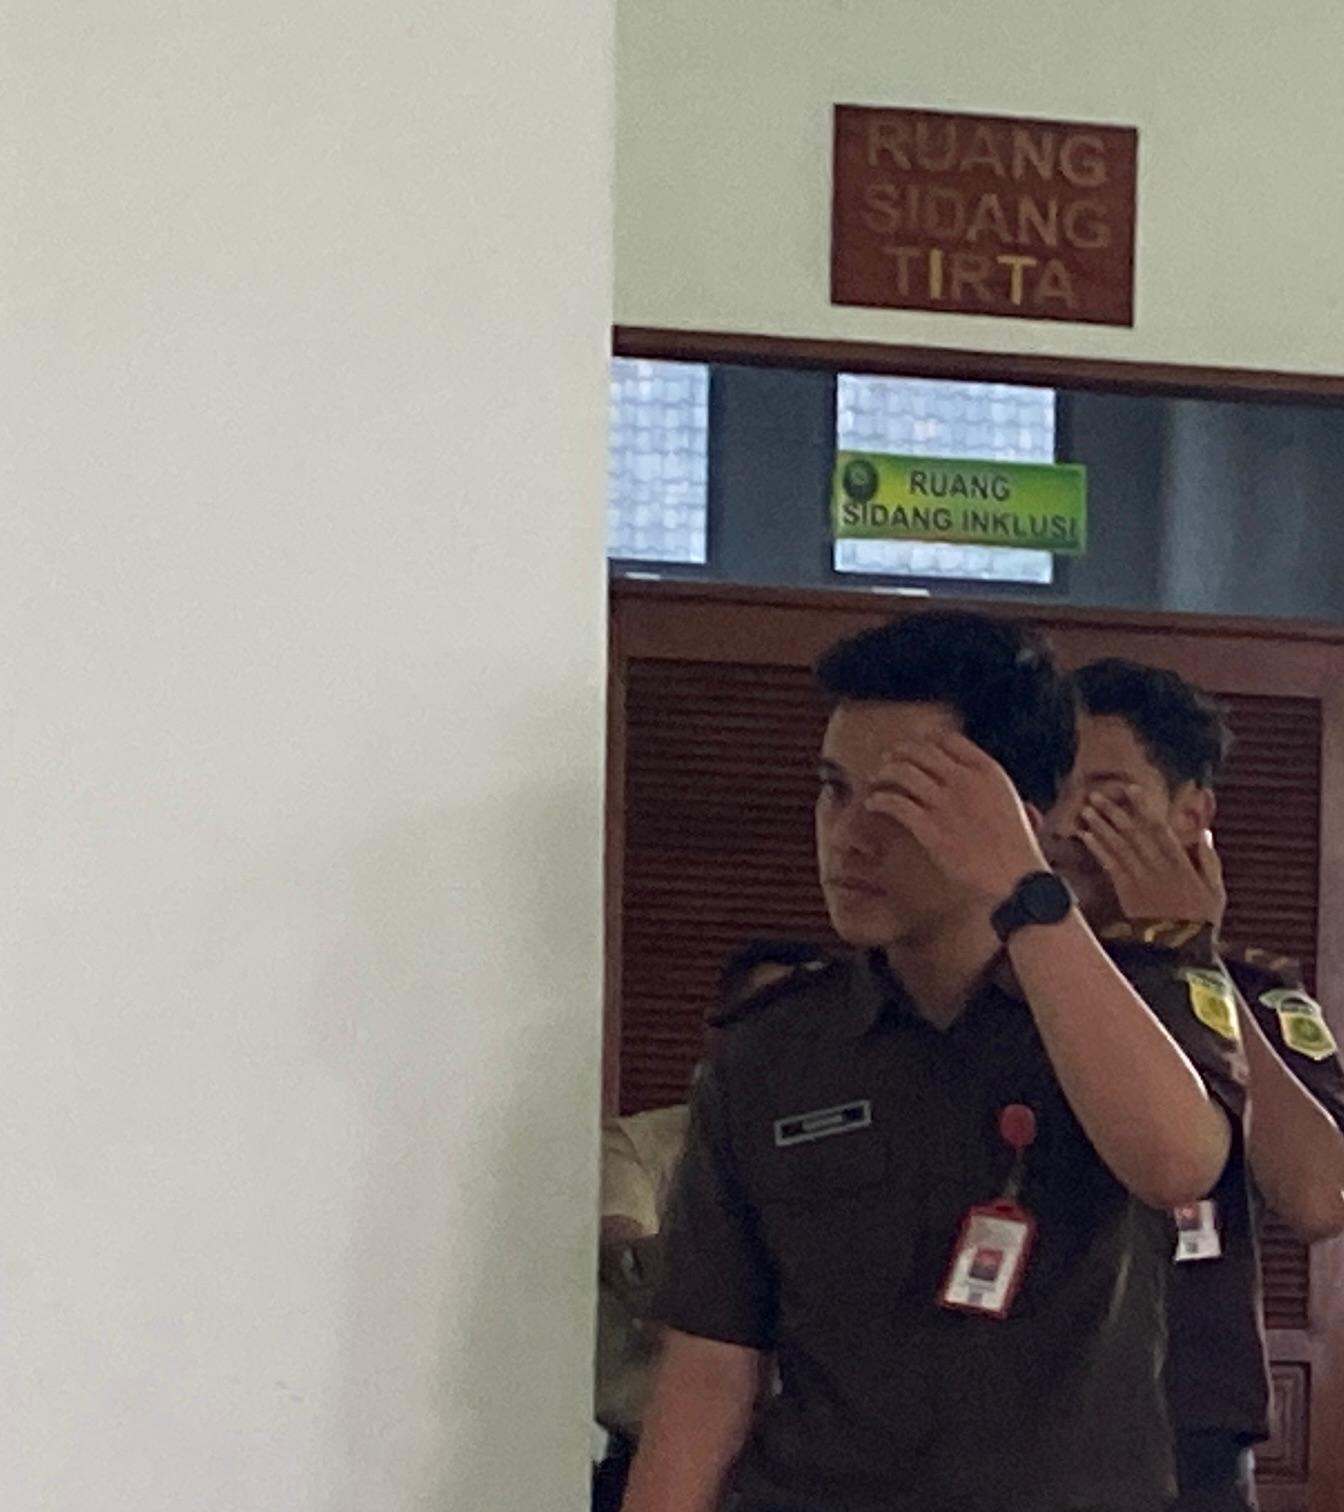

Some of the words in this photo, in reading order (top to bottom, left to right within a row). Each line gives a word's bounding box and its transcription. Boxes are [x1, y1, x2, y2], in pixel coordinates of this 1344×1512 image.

[868, 118, 1107, 187] RUANG
[863, 182, 1111, 249] SIDANG
[885, 246, 1078, 308] TIRTA
[909, 470, 1011, 500] RUANG
[842, 503, 952, 531] SIDANG
[962, 509, 1077, 539] INKLUSI
